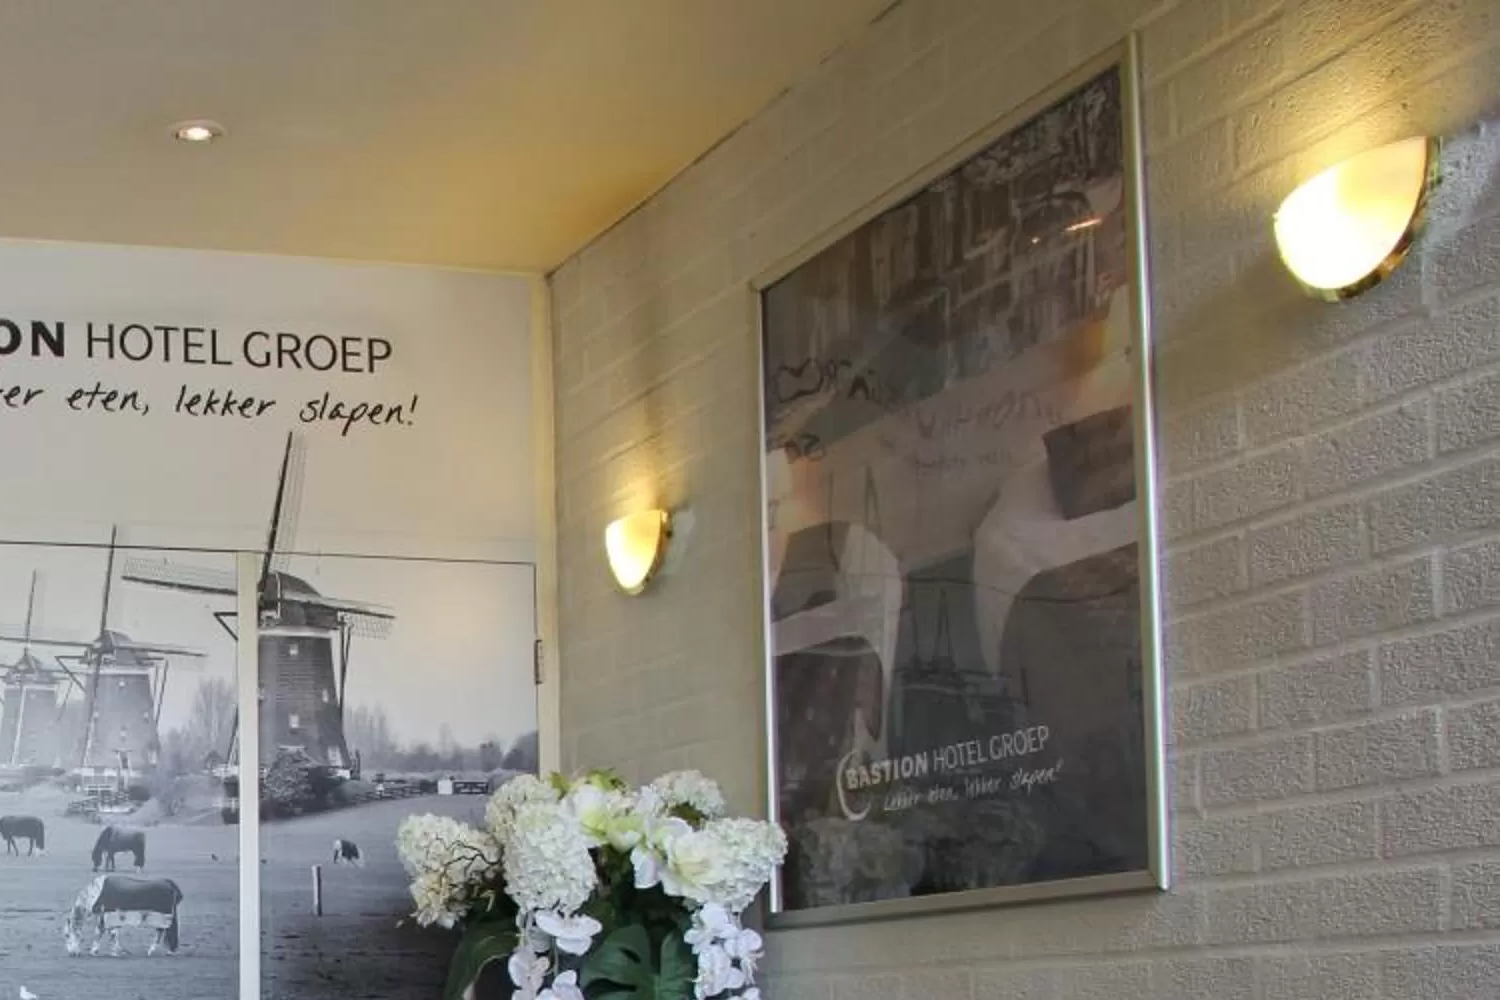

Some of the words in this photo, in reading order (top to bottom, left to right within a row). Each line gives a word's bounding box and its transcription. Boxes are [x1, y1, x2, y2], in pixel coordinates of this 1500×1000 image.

[86, 322, 232, 366] HOTEL
[243, 331, 393, 374] GROEP
[67, 381, 149, 415] eten,
[175, 384, 276, 418] lekker
[299, 394, 419, 437] slapen!
[846, 752, 929, 790] BASTION
[933, 739, 989, 772] HOTEL
[989, 724, 1049, 761] GROEP
